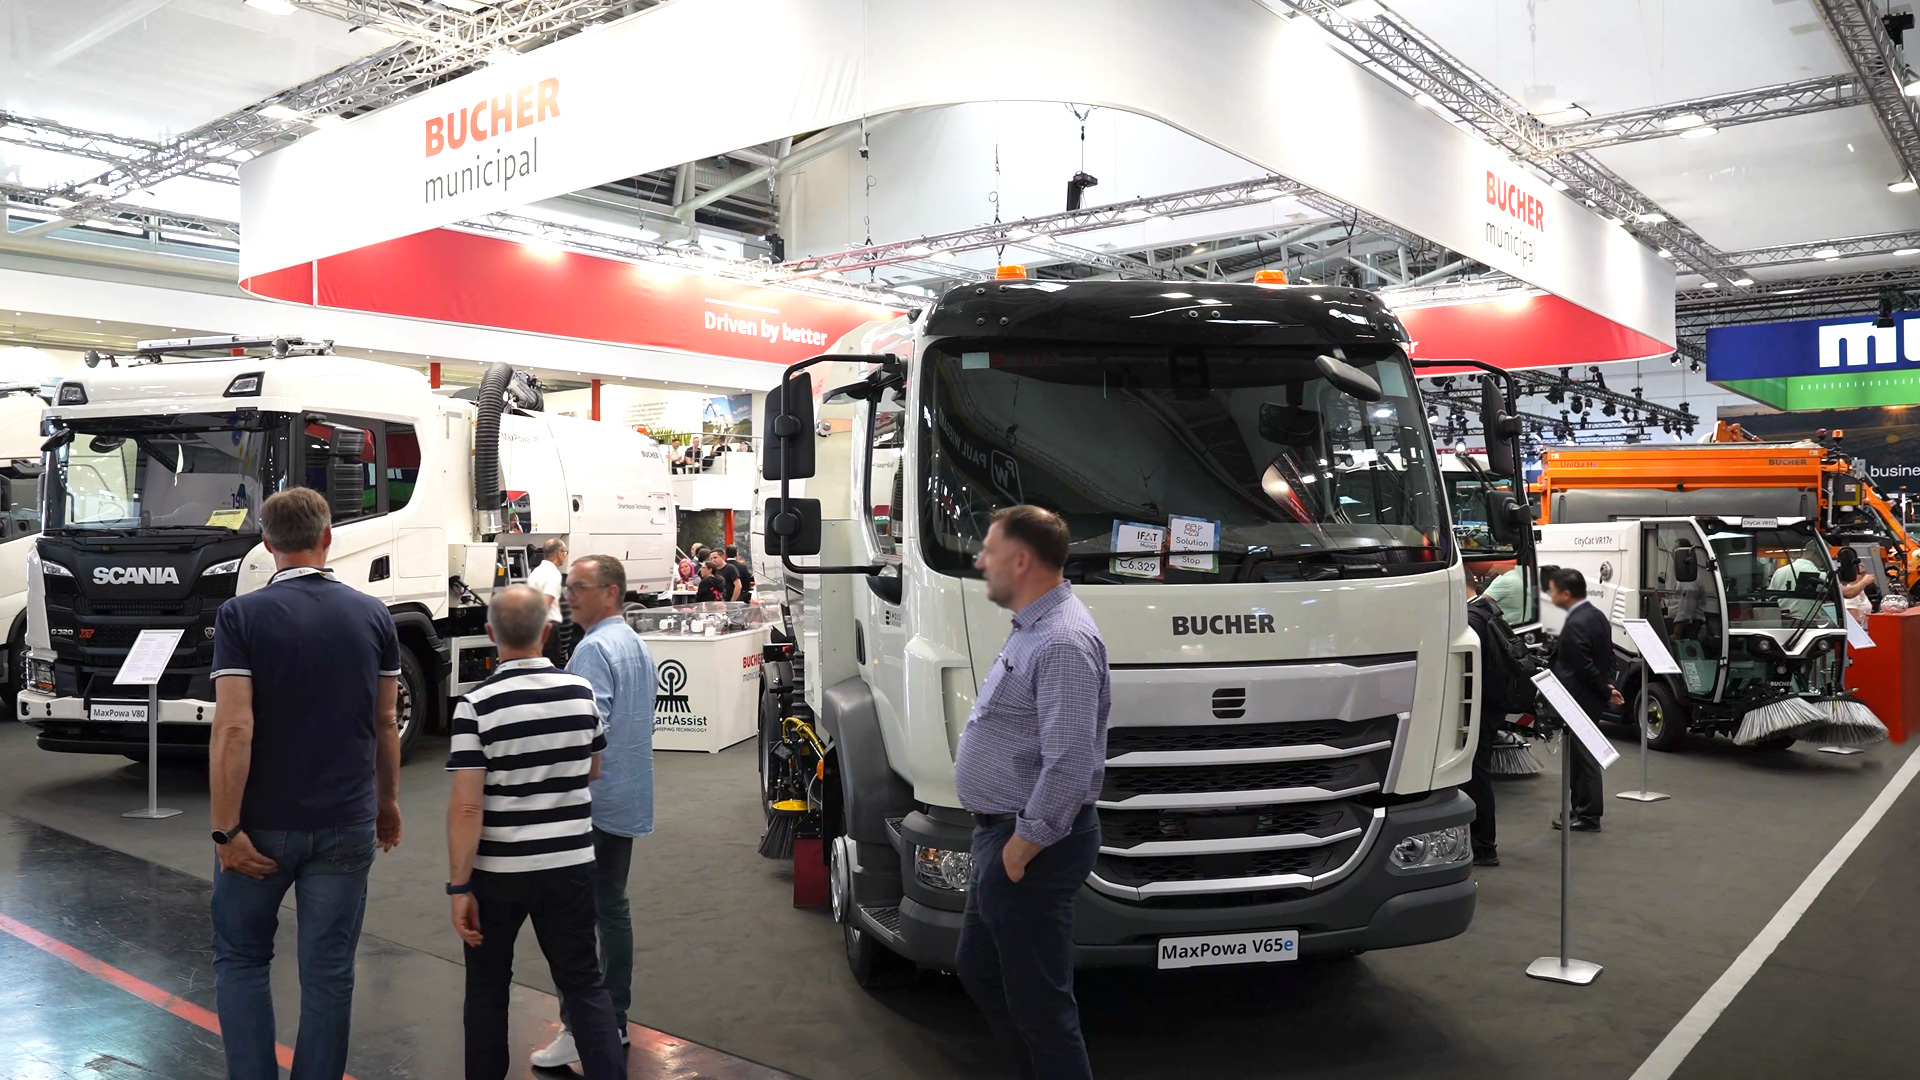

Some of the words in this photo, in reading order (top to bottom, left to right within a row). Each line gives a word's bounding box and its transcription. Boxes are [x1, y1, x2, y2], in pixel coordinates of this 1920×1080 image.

[425, 77, 561, 158] BUCHER
[425, 136, 537, 203] municipal
[1486, 169, 1544, 232] BUCHER
[1485, 221, 1536, 267] municipal
[704, 310, 758, 337] Driven
[760, 318, 780, 344] by
[782, 322, 828, 346] better
[641, 450, 659, 459] BUCHER
[1768, 458, 1807, 466] BUCHER
[1137, 531, 1158, 542] IFAT
[1175, 536, 1209, 547] Solution
[1574, 537, 1594, 547] CityCat
[1595, 536, 1613, 544] VR17e
[1140, 542, 1158, 550] Munich
[1120, 560, 1156, 572] C6.329
[1181, 555, 1201, 565] Stop
[92, 566, 180, 585] SCANIA
[1172, 614, 1276, 636] BUCHER
[57, 628, 74, 636] 320
[93, 708, 130, 718] MaxPowa
[131, 708, 145, 718] V80
[655, 714, 708, 726] artAssist
[1162, 942, 1247, 960] MaxPowa
[1252, 937, 1294, 953] V65e
